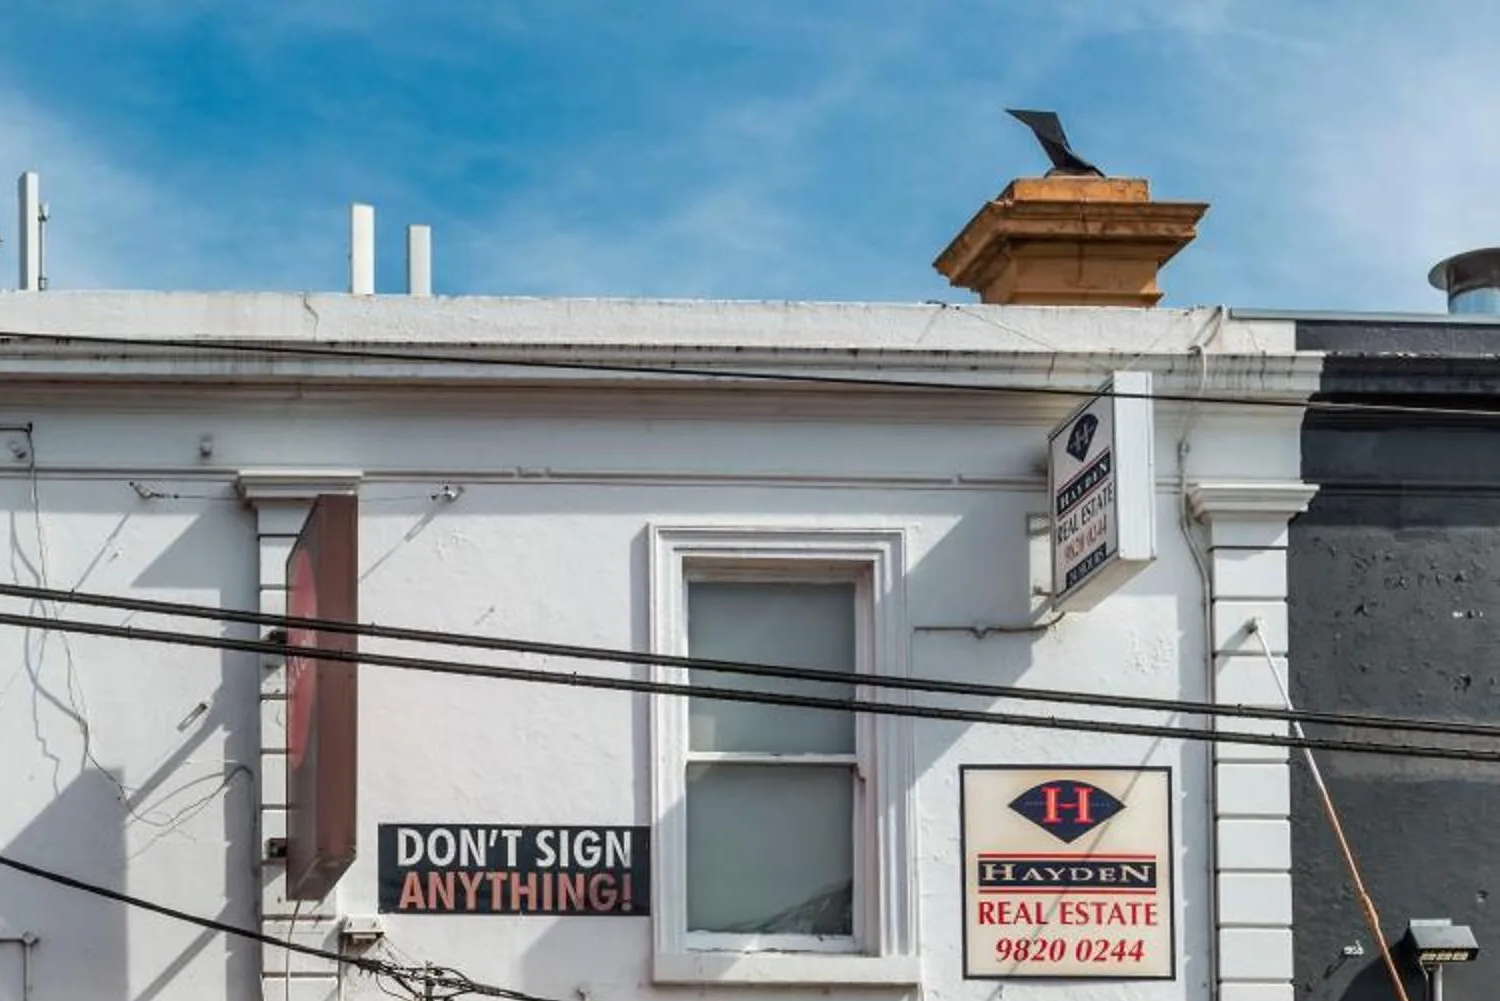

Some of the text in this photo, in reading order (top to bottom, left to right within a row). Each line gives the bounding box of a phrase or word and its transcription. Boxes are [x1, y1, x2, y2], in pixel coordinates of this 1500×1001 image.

[1057, 481, 1114, 545] REAL ESTATE
[1041, 787, 1094, 824] H
[397, 828, 632, 868] DON'T SIGN
[399, 871, 634, 912] ANYTHING!
[981, 863, 1152, 883] HAYDEN
[978, 901, 1159, 926] REAL ESTATE
[995, 938, 1145, 963] 9820 0244
